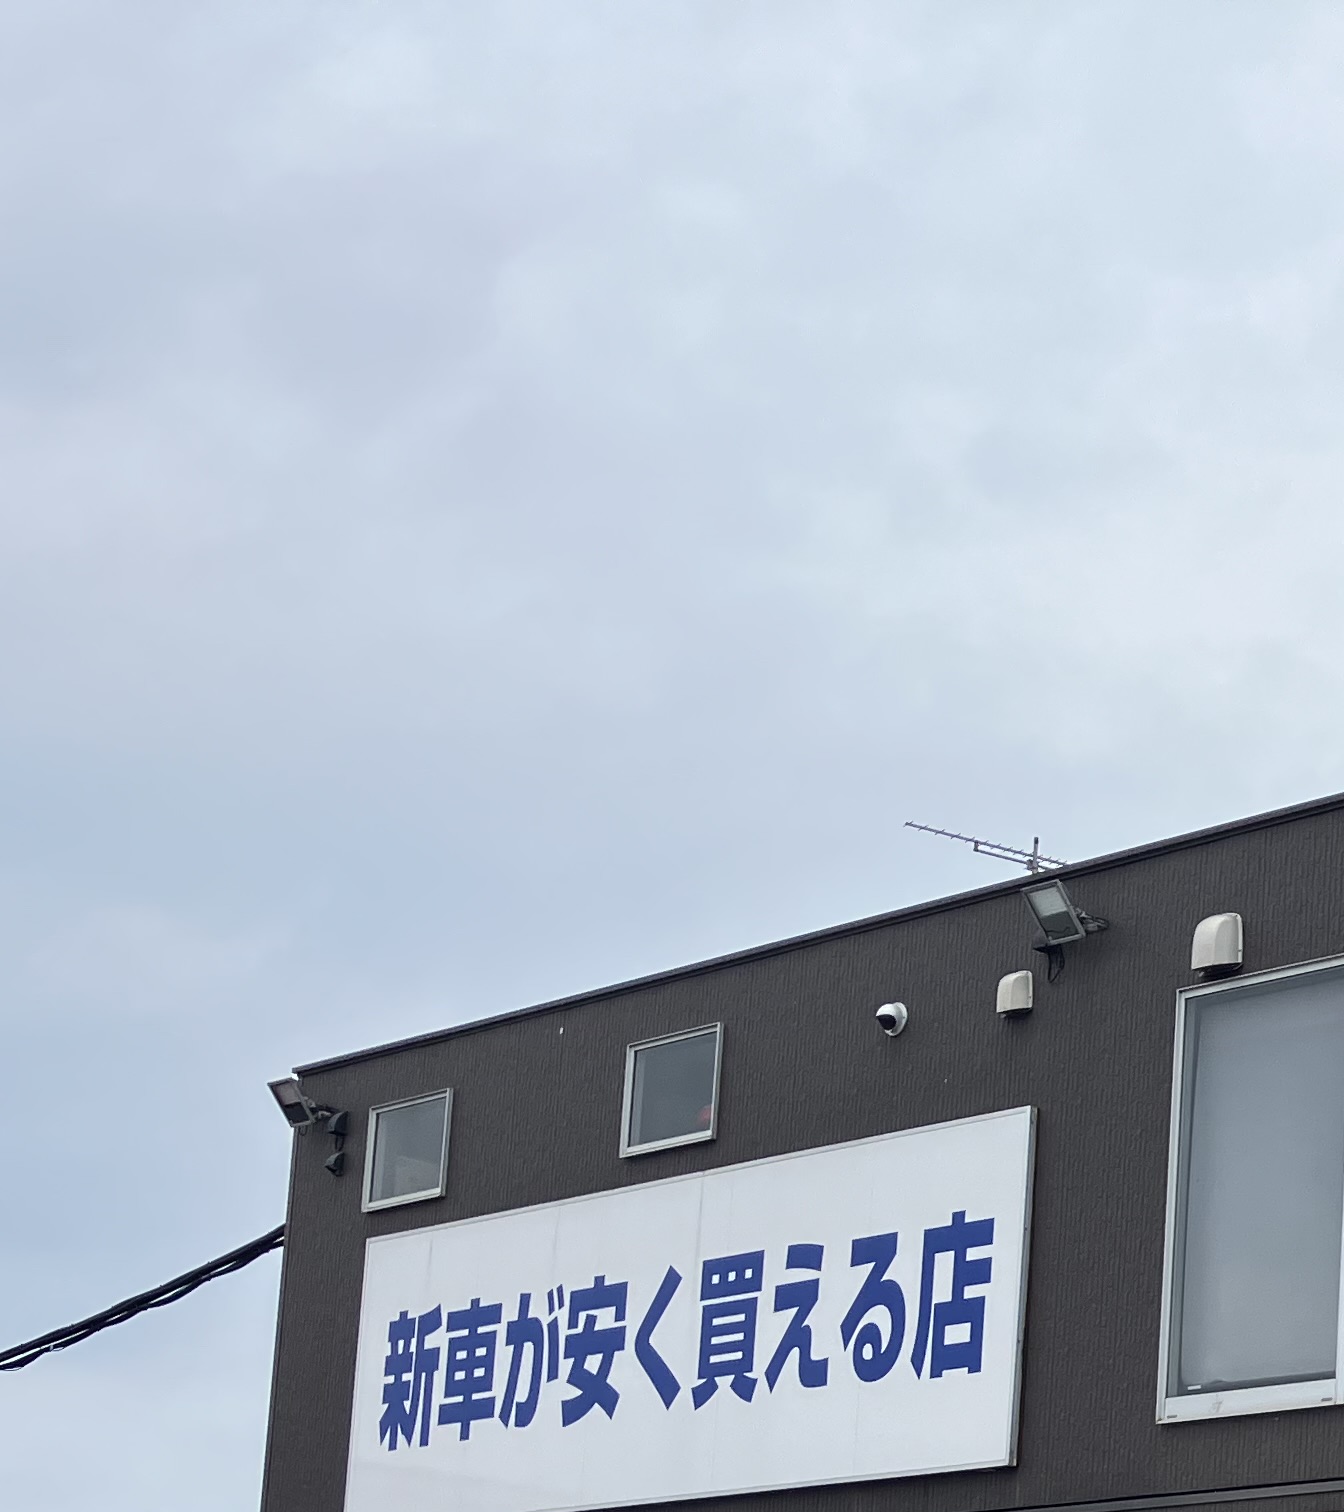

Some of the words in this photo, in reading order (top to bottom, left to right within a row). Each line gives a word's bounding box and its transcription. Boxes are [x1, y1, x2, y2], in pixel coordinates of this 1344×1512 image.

[378, 1209, 996, 1453] 新車が安く買える店
